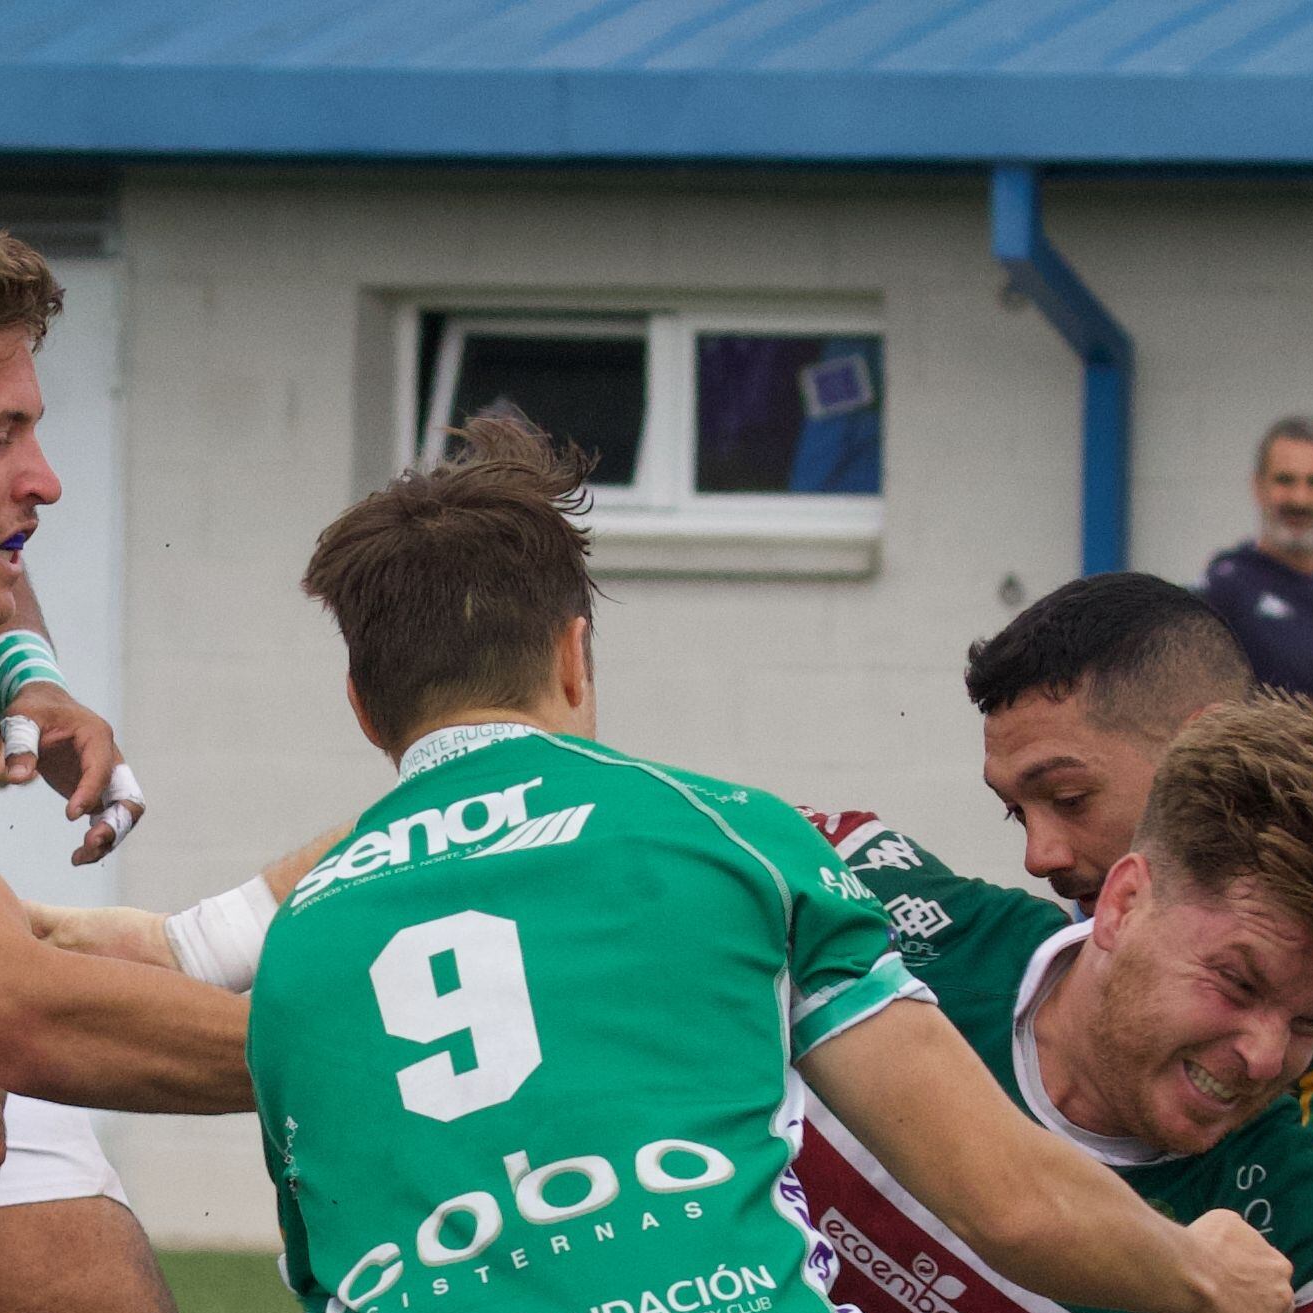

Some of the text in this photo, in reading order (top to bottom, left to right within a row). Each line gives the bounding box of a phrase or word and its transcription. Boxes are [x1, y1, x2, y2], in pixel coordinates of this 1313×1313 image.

[453, 723, 516, 745] RUGBY
[290, 776, 543, 909] senor
[369, 909, 543, 1123] 9
[337, 1138, 737, 1311] cobo
